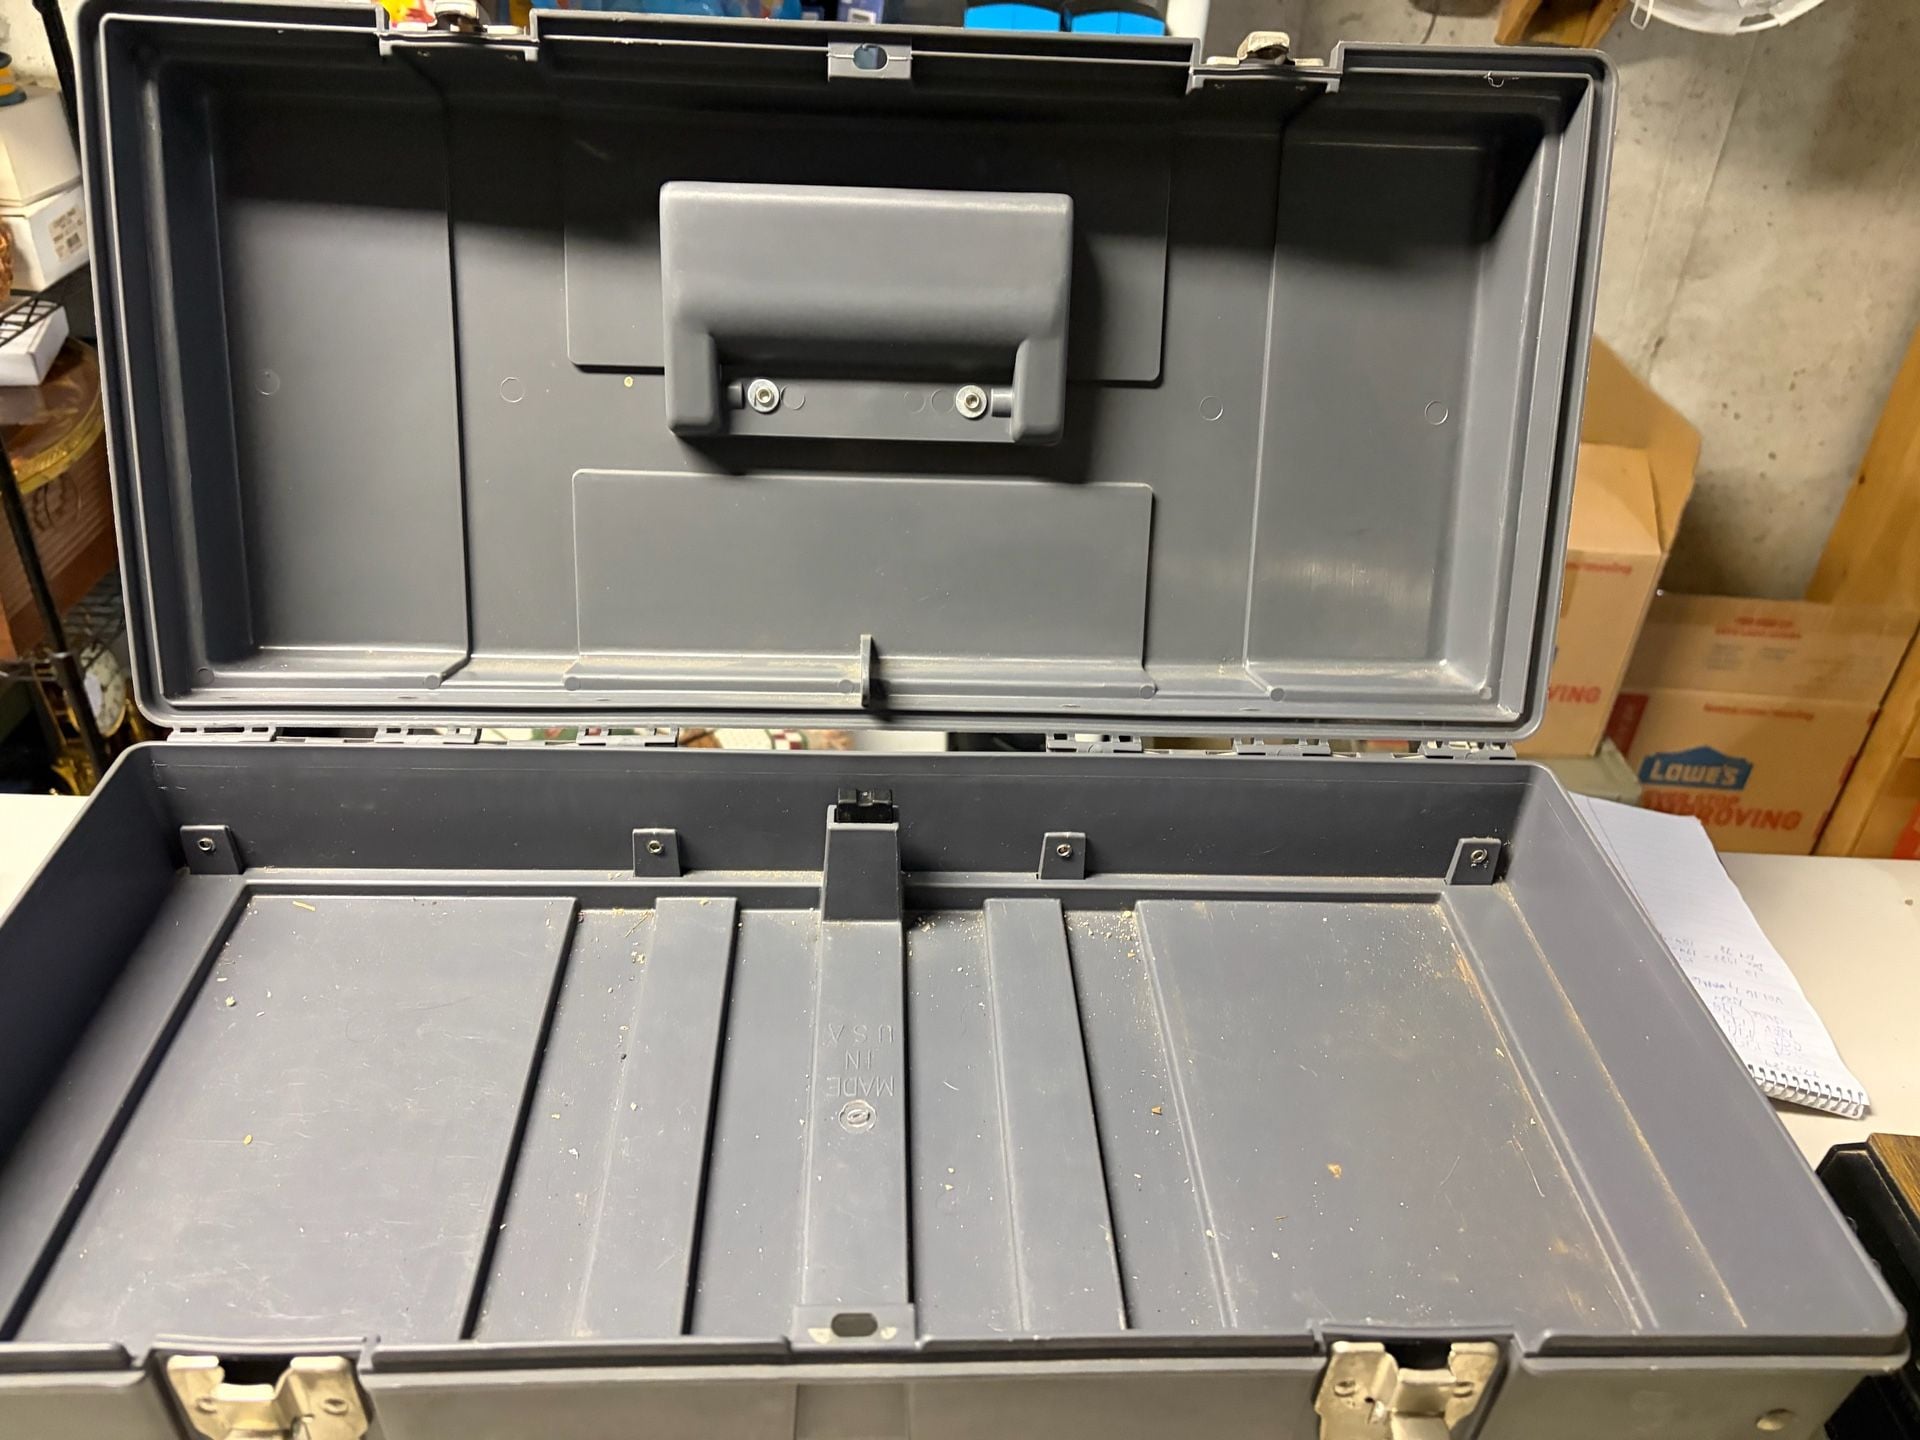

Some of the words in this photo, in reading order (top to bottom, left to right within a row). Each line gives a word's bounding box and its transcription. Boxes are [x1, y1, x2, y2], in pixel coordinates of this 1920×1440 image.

[1649, 760, 1740, 785] LOWE'S
[844, 1050, 873, 1070] IN
[826, 1076, 894, 1097] MADE
